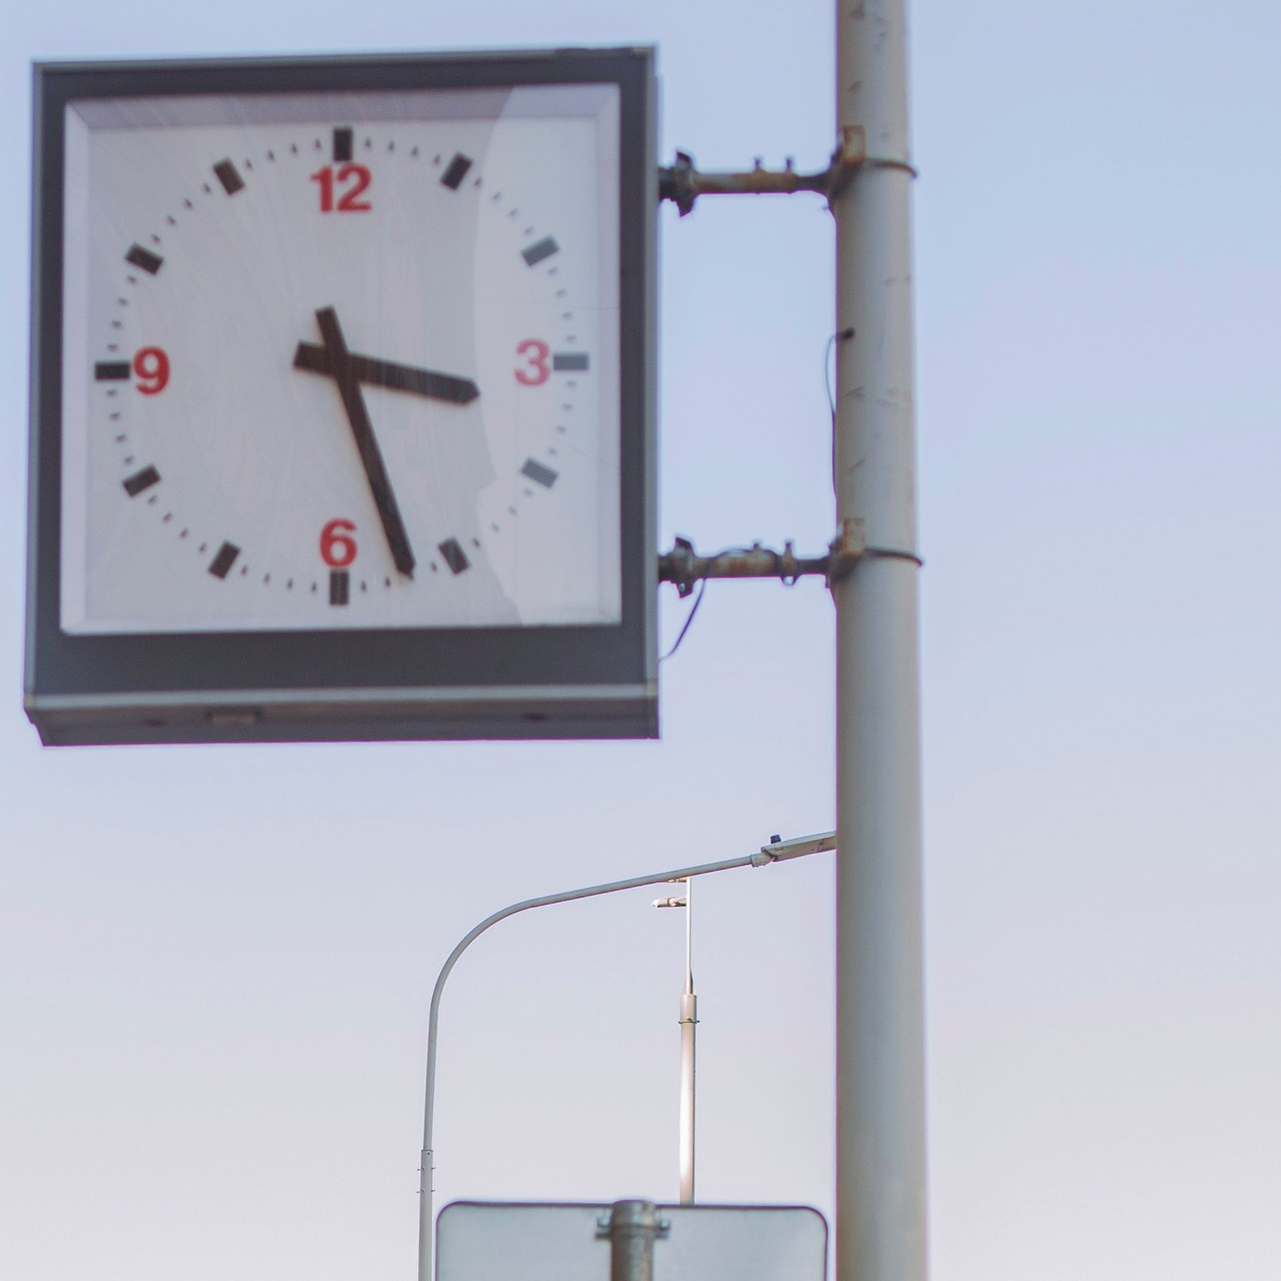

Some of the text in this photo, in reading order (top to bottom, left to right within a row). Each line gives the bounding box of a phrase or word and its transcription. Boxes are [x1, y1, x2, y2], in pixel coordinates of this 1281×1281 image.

[310, 163, 372, 212] 12
[133, 339, 550, 394] 9 3
[319, 518, 357, 567] 6
